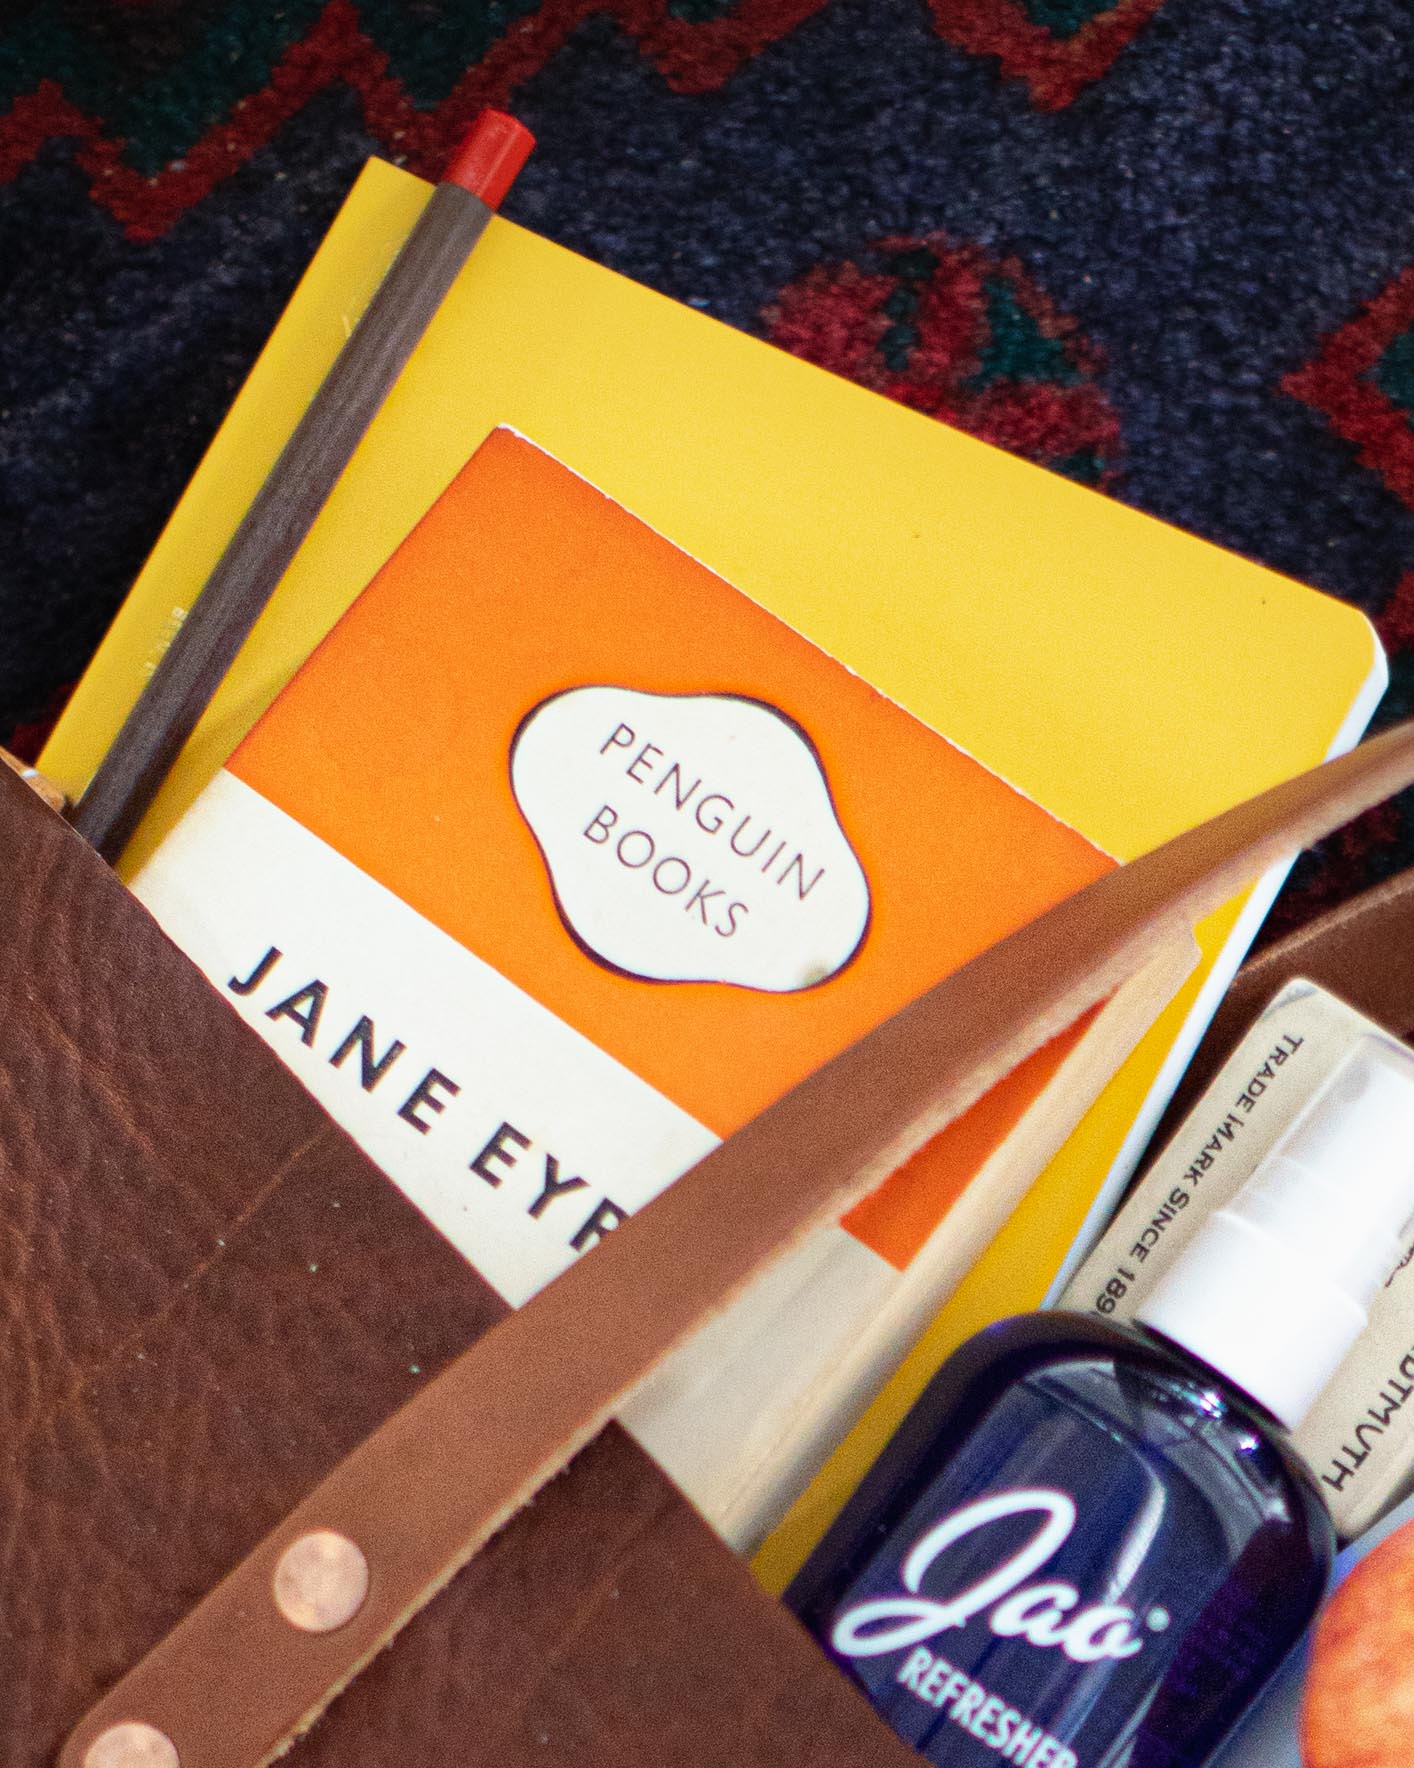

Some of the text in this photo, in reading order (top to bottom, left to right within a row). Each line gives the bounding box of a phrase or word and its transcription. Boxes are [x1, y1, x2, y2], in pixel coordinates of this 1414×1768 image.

[582, 804, 750, 939] BOOKS
[599, 722, 826, 901] PENGUIN
[227, 946, 629, 1252] JANE EYR
[1091, 1033, 1304, 1316] TRADE MARK SINCE 189
